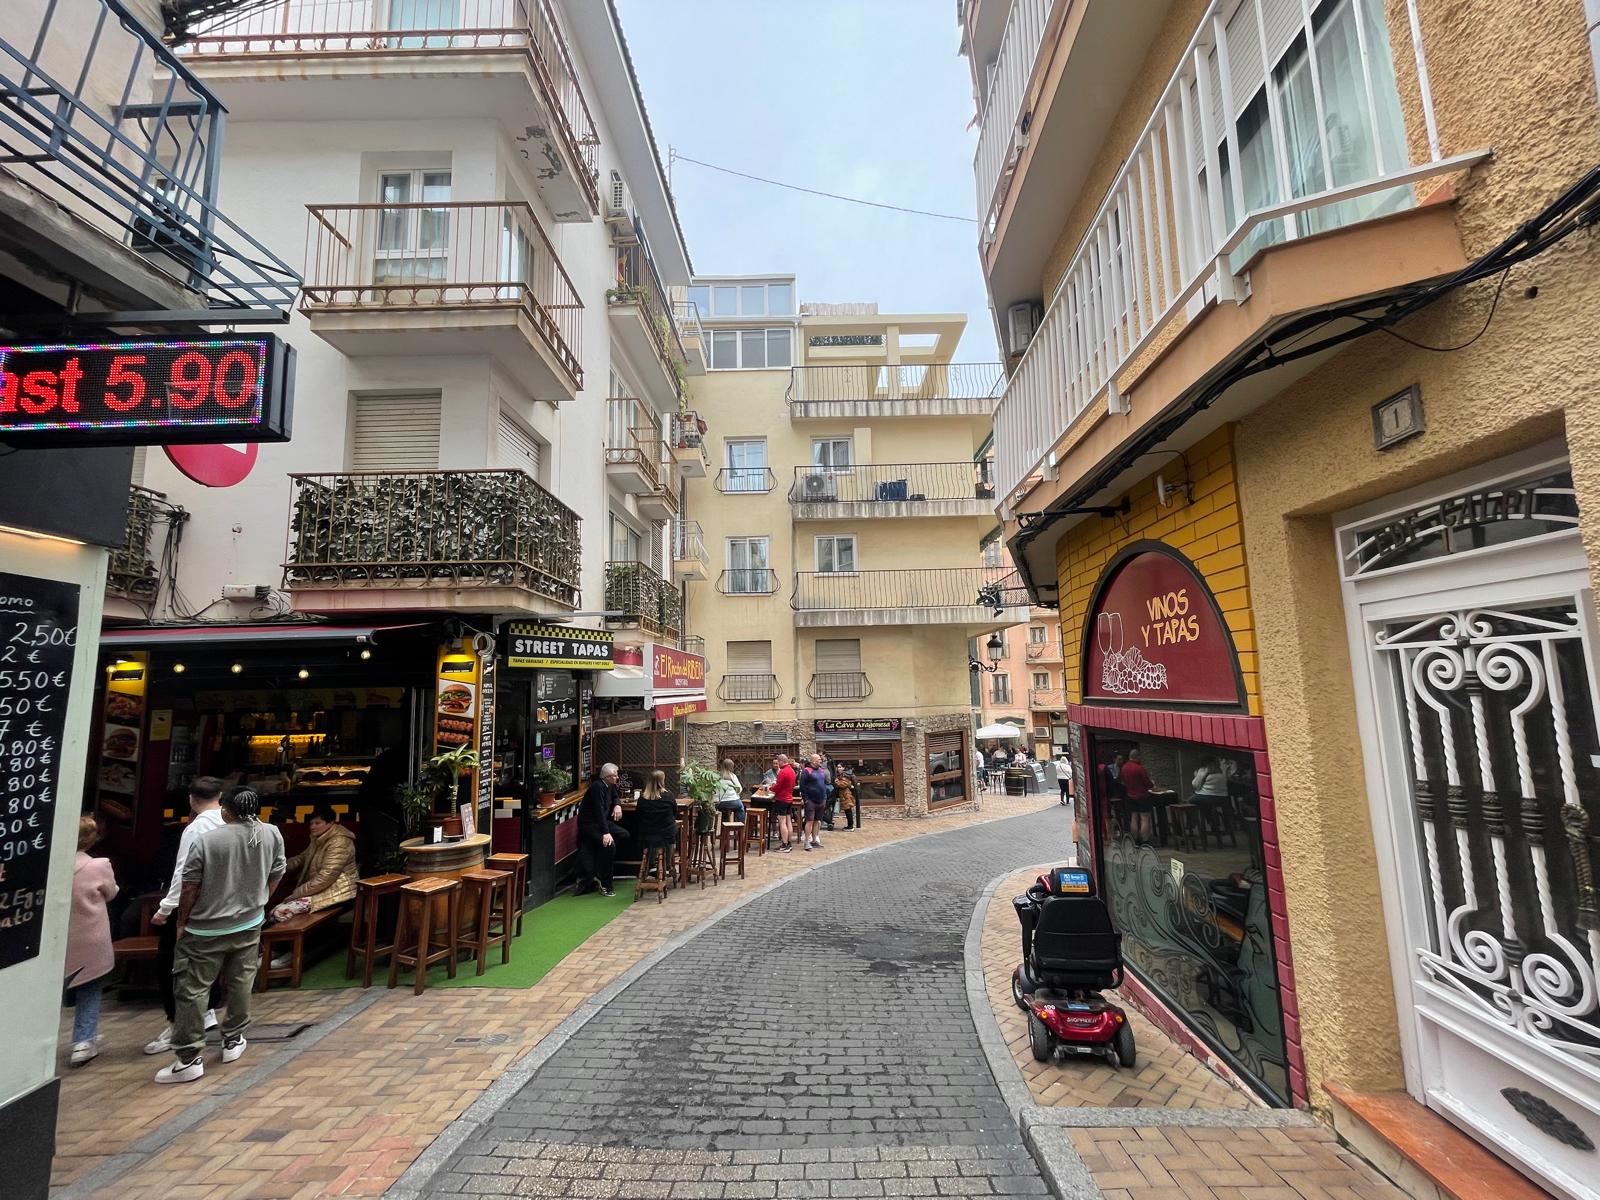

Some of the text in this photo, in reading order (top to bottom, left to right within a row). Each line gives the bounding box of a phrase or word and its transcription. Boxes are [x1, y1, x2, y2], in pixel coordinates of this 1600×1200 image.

[104, 351, 257, 411] 5.90
[1392, 407, 1400, 429] 1
[1146, 588, 1189, 621] VINOS
[1141, 614, 1200, 648] Y TAPAS
[515, 639, 609, 657] STREET TAPAS
[825, 721, 891, 729] La Cava Aragonesa
